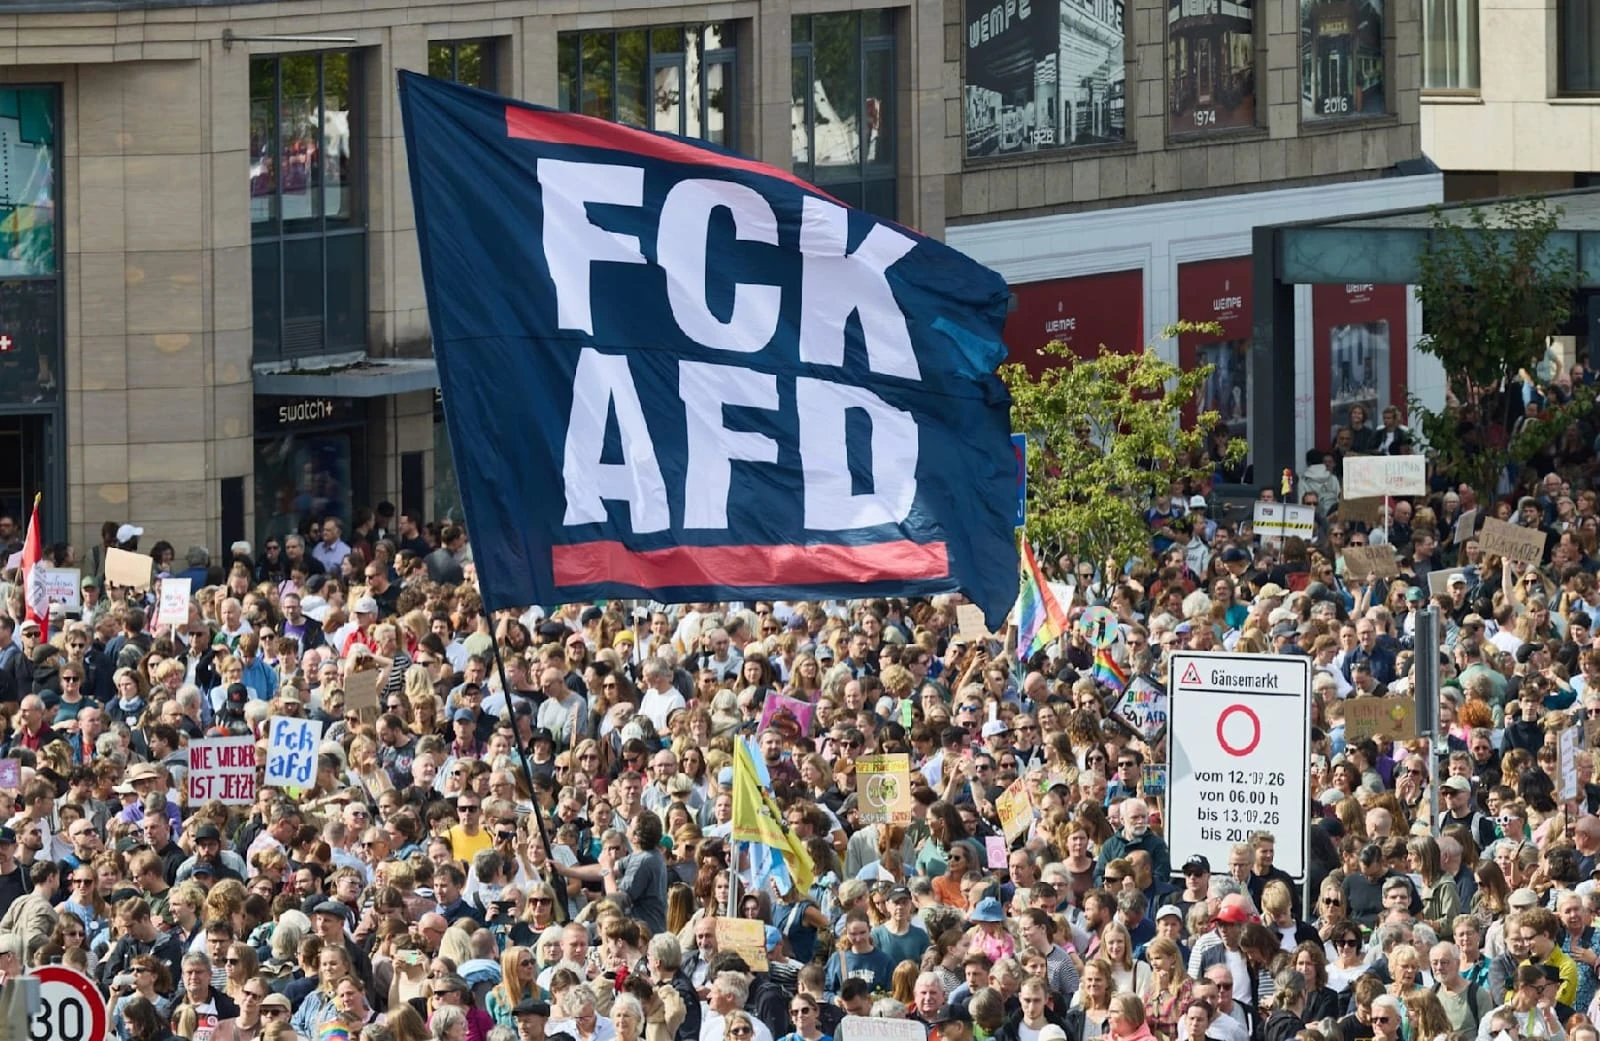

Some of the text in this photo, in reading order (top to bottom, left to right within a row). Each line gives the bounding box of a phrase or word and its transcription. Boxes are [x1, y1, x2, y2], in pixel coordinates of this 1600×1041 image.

[969, 0, 1032, 48] WEMPE
[1323, 97, 1348, 114] 2016
[1193, 110, 1216, 126] 1974
[1030, 129, 1054, 145] 1928
[537, 157, 921, 380] FCK
[1213, 296, 1242, 310] WEMPE
[1045, 317, 1076, 333] WEMPE
[562, 347, 919, 533] AFD
[1211, 670, 1279, 689] Gänsemarkt
[190, 744, 256, 770] NIE WIEDER
[1194, 771, 1223, 783] vom
[190, 775, 215, 799] IST
[1200, 790, 1279, 805] von 06.00 h
[1197, 807, 1218, 822] bis
[1201, 827, 1221, 841] bis
[27, 997, 84, 1041] 30
